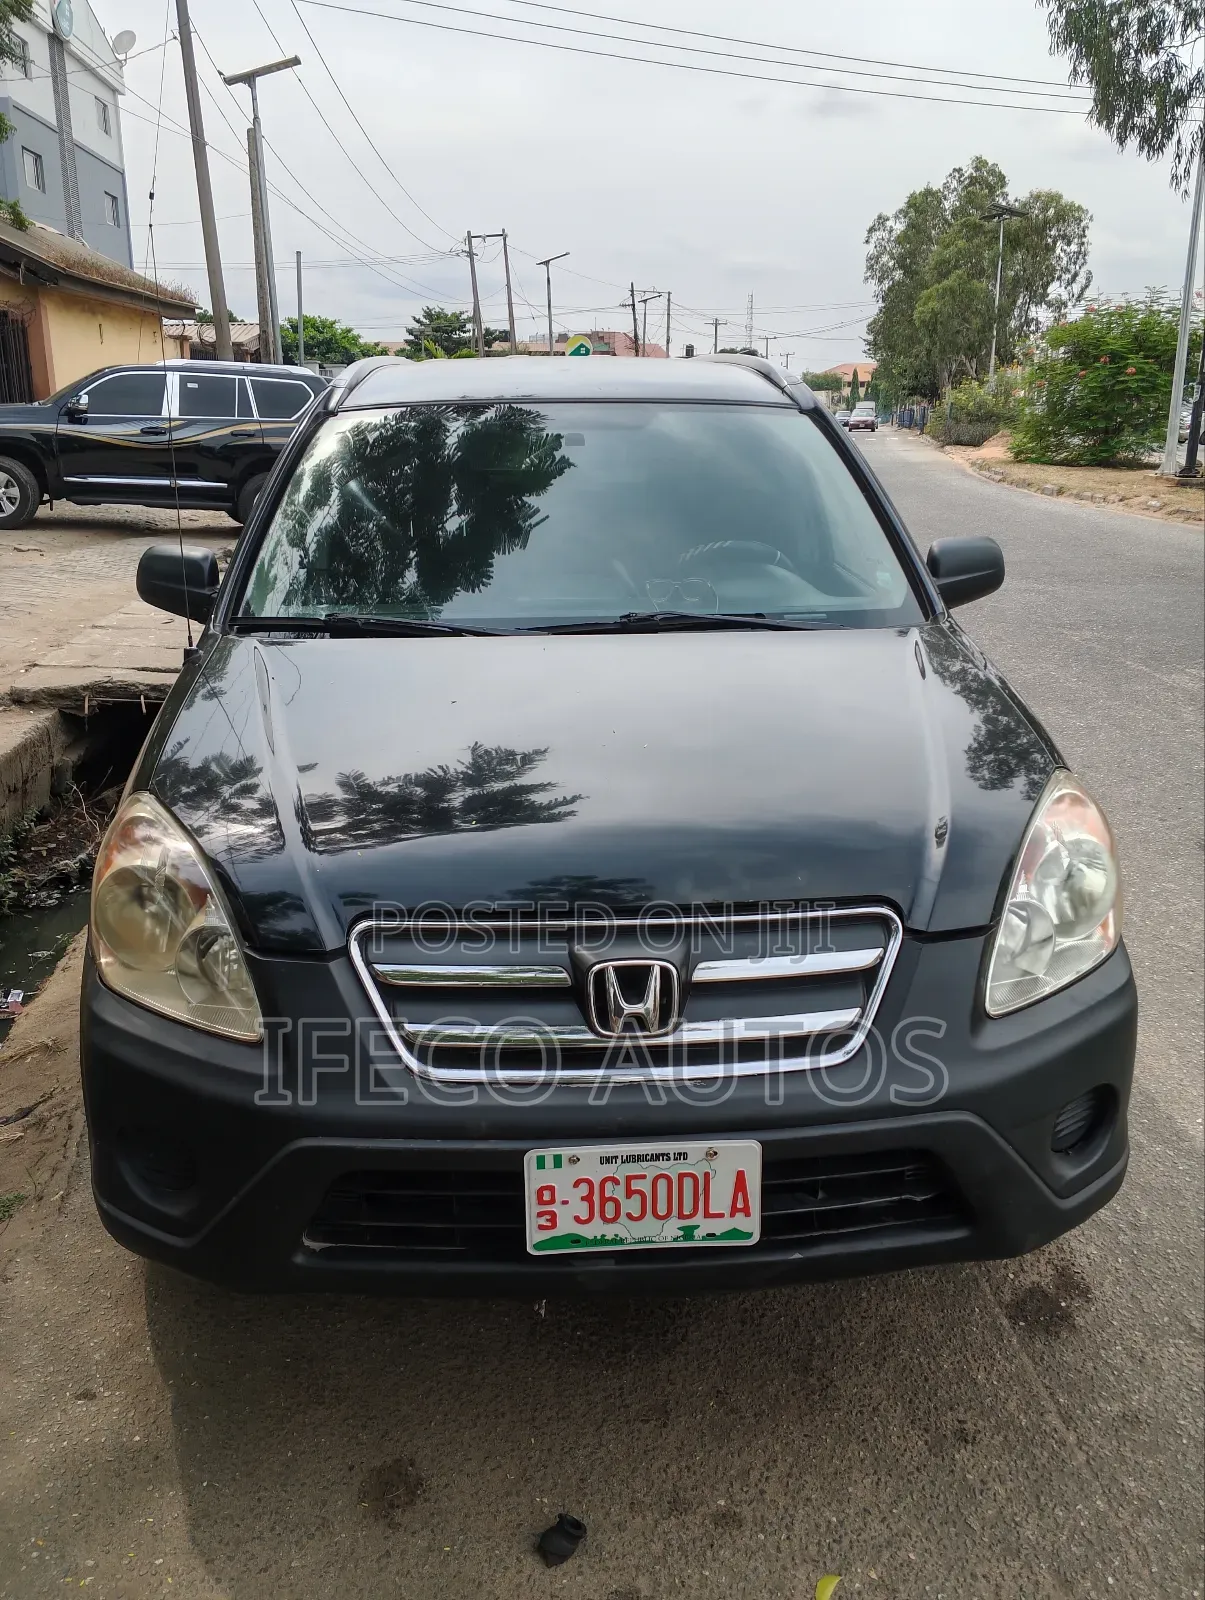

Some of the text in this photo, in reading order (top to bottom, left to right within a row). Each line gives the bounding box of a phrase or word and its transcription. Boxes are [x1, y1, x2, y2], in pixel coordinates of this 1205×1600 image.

[599, 1151, 689, 1165] UNIT LUBRICANTS LTD
